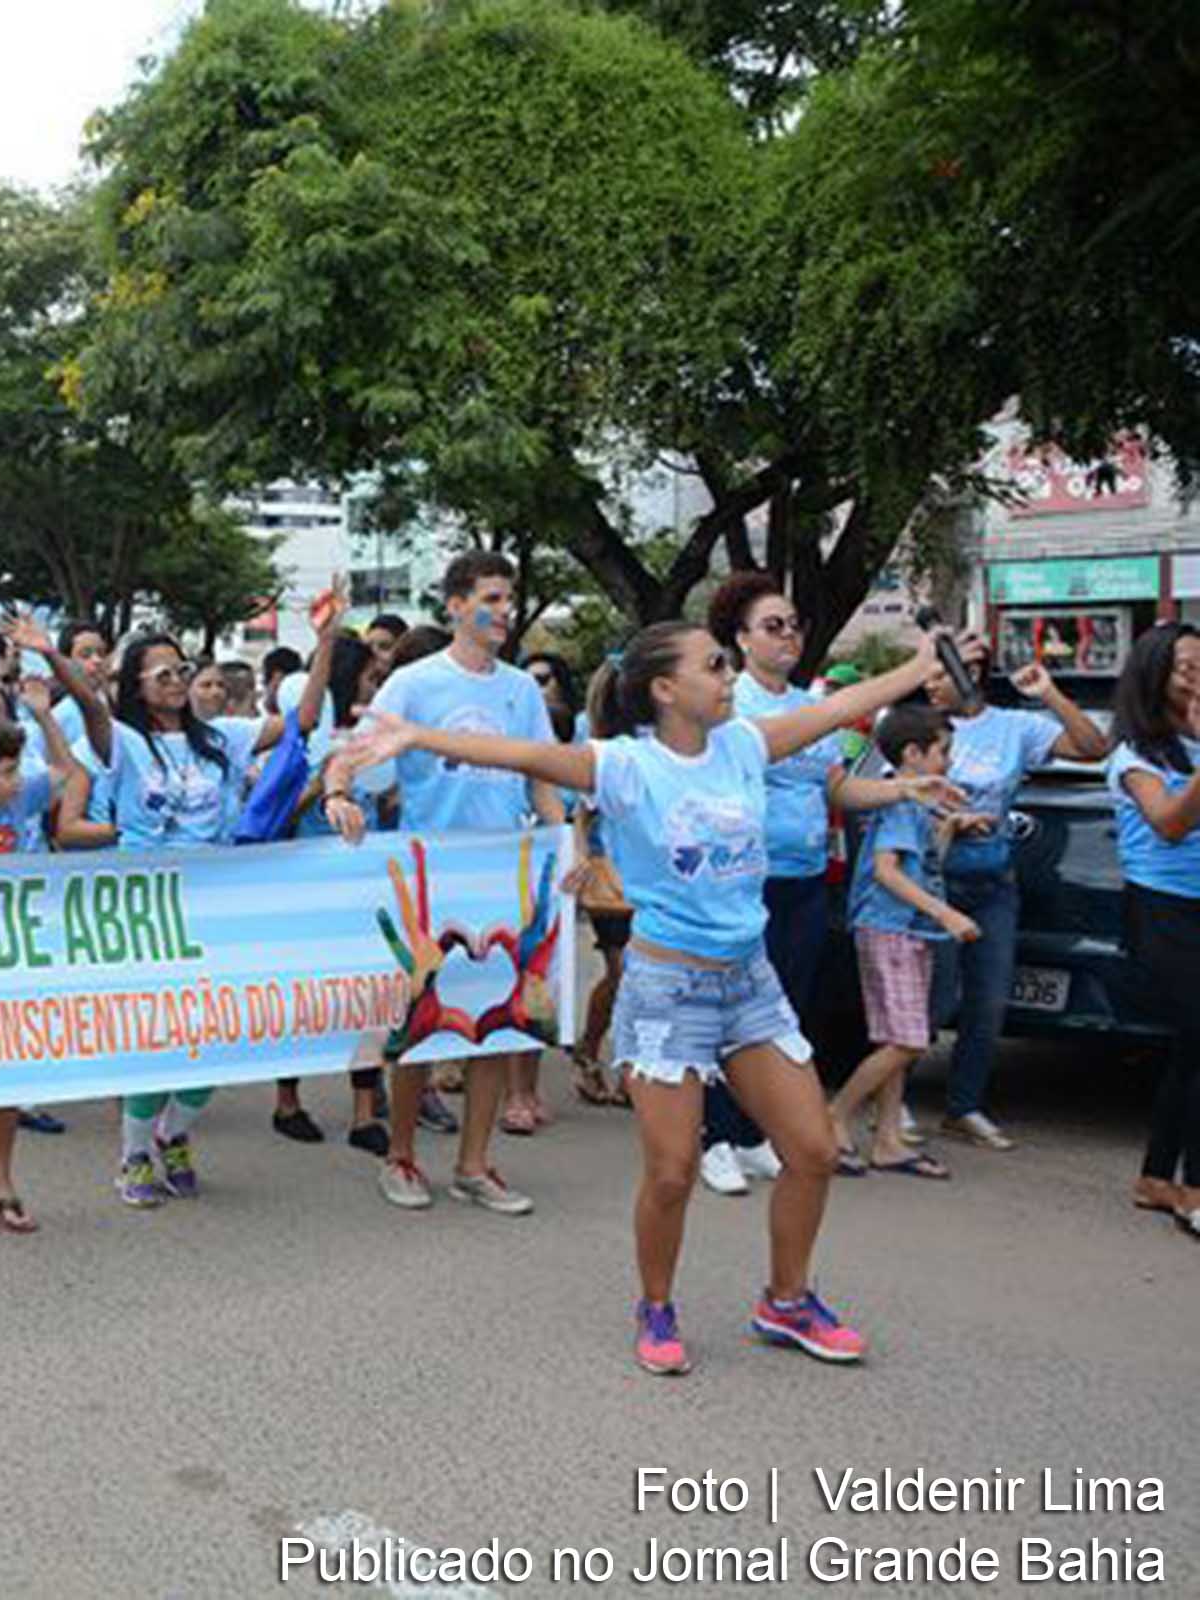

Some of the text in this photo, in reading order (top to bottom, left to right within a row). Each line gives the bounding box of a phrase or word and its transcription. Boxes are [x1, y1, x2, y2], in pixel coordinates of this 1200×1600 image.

[63, 871, 204, 965] ABRIL
[245, 980, 286, 1041] DO
[292, 969, 409, 1036] AUTISMO
